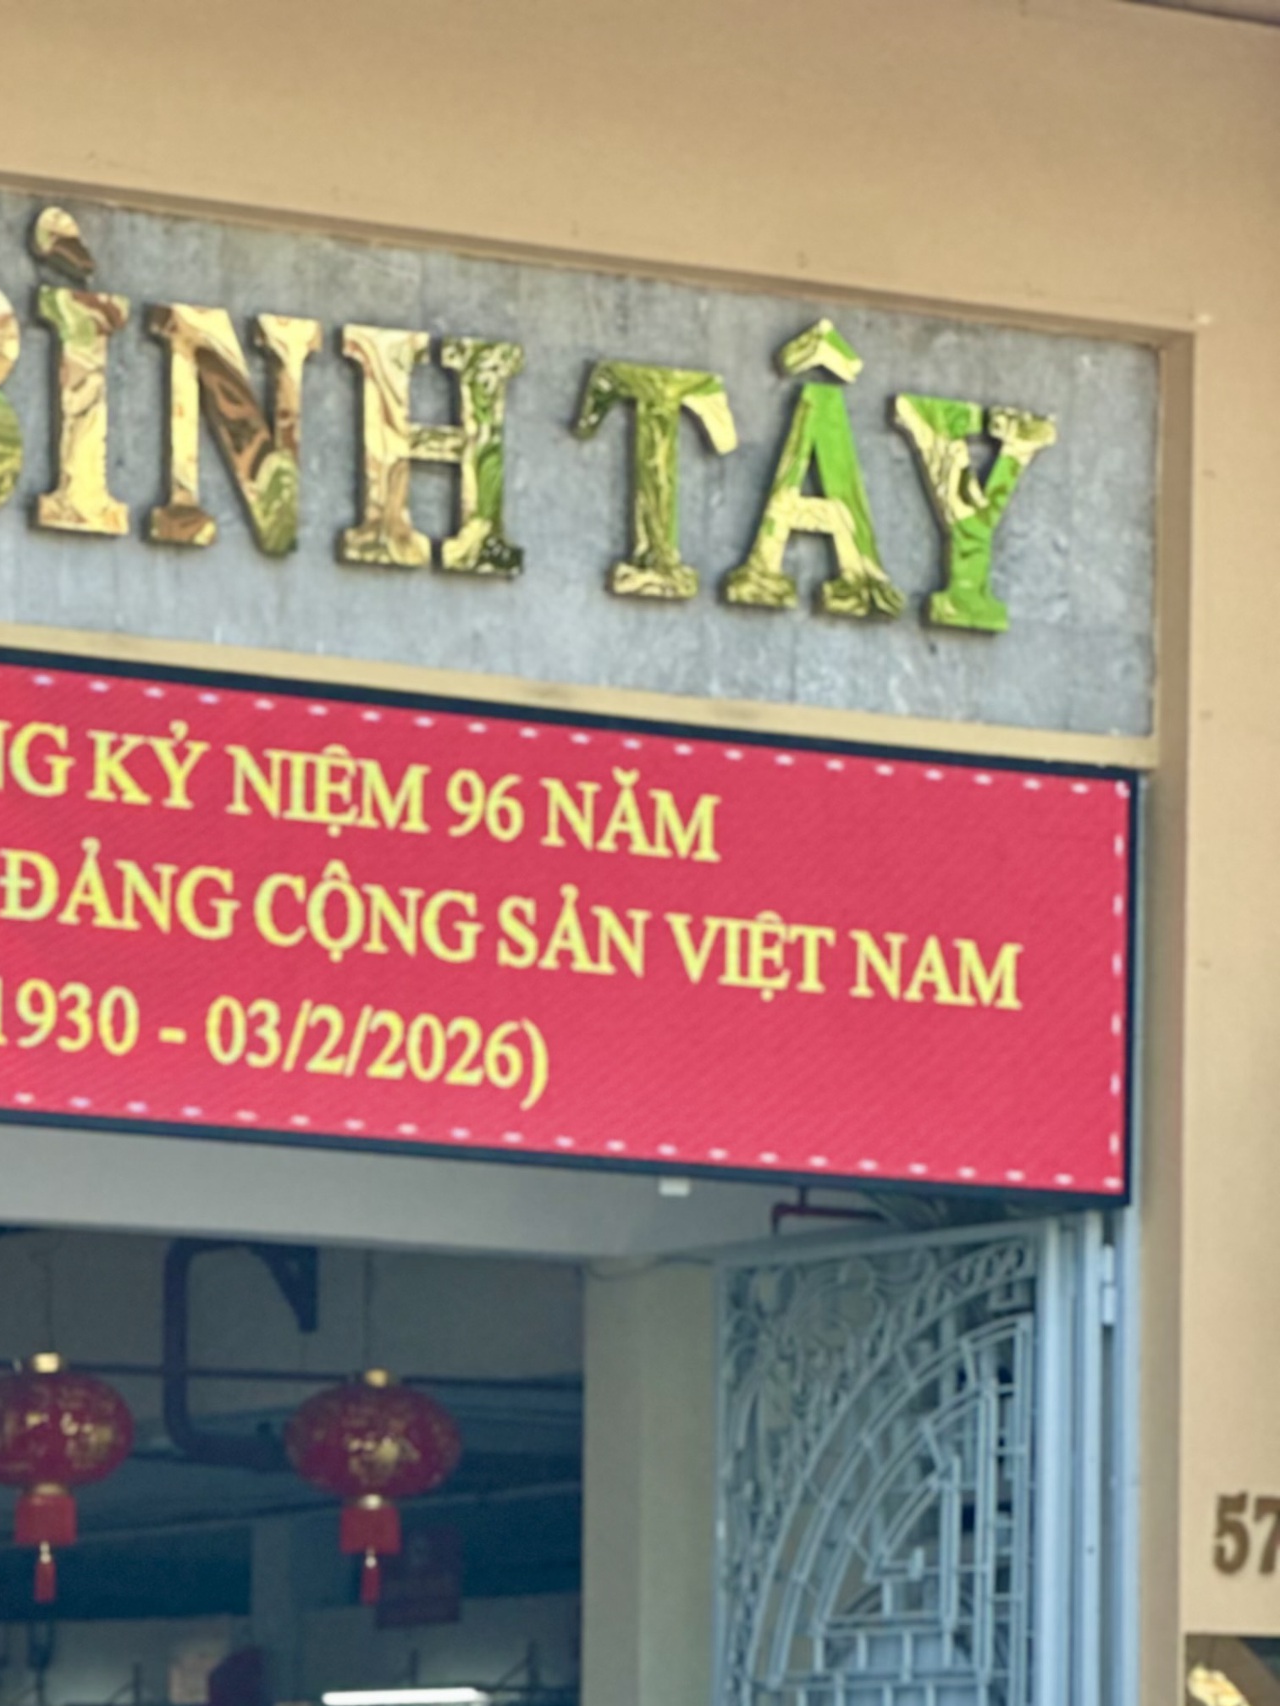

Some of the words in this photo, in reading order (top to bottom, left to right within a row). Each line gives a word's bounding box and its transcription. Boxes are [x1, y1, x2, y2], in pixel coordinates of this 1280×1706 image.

[572, 318, 1056, 632] TÂY
[87, 720, 209, 809] KỶ
[226, 744, 429, 837] NIỆM
[446, 769, 524, 842] 96
[541, 767, 720, 862] NĂM
[254, 859, 482, 963] CỘNG
[497, 884, 650, 977] SẢN
[665, 910, 836, 1001] VIỆT
[850, 930, 1022, 1010] NAM
[159, 1027, 186, 1044] -
[206, 995, 549, 1110] 03/2/2026)
[1214, 1492, 1280, 1576] 57
